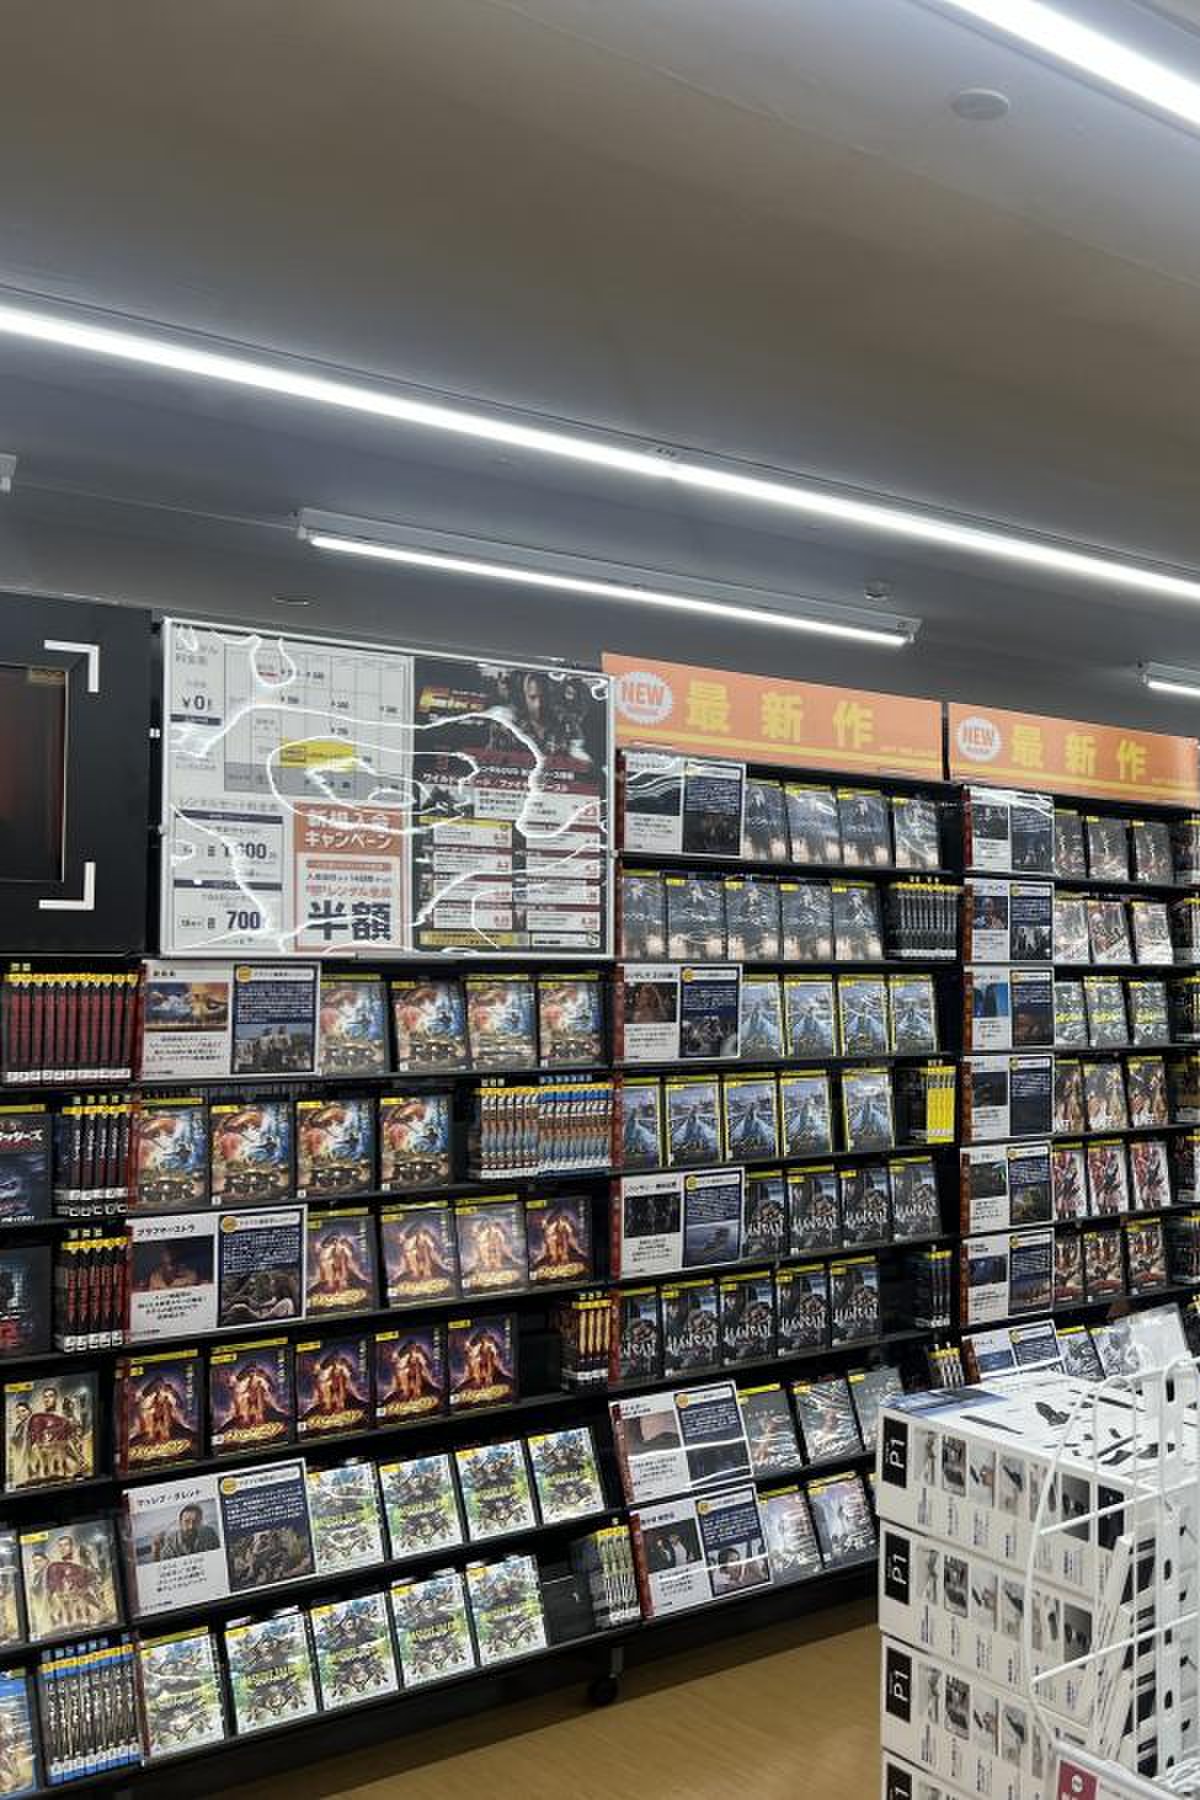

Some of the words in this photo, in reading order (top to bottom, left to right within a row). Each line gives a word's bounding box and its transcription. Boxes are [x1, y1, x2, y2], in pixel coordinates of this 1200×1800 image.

[621, 680, 668, 703] NEW
[684, 679, 874, 748] 最新作
[1010, 723, 1148, 782] 最新作
[304, 830, 394, 850] キャンペーン
[226, 910, 262, 930] 700
[306, 899, 393, 942] 半額
[890, 1438, 906, 1469] P1
[891, 1551, 908, 1585] P1
[893, 1669, 909, 1702] P1
